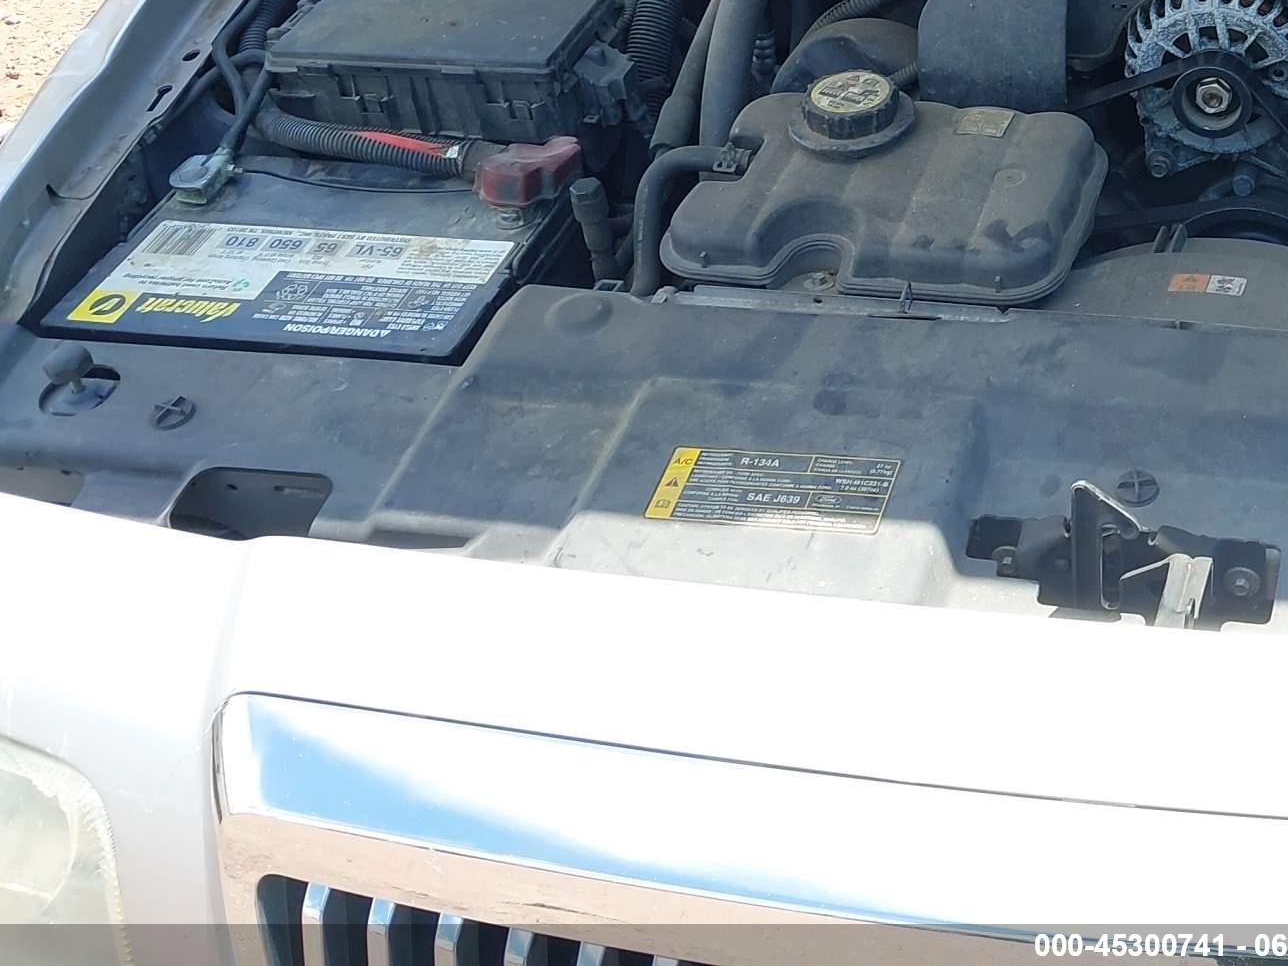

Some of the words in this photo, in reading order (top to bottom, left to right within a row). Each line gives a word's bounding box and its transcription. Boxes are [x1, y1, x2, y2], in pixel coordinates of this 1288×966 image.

[225, 236, 259, 247] 810
[269, 239, 303, 250] 650
[313, 243, 337, 253] 65
[354, 245, 403, 257] 65-VL
[741, 457, 780, 468] R-134A
[747, 493, 771, 502] SAE
[773, 495, 801, 504] J639
